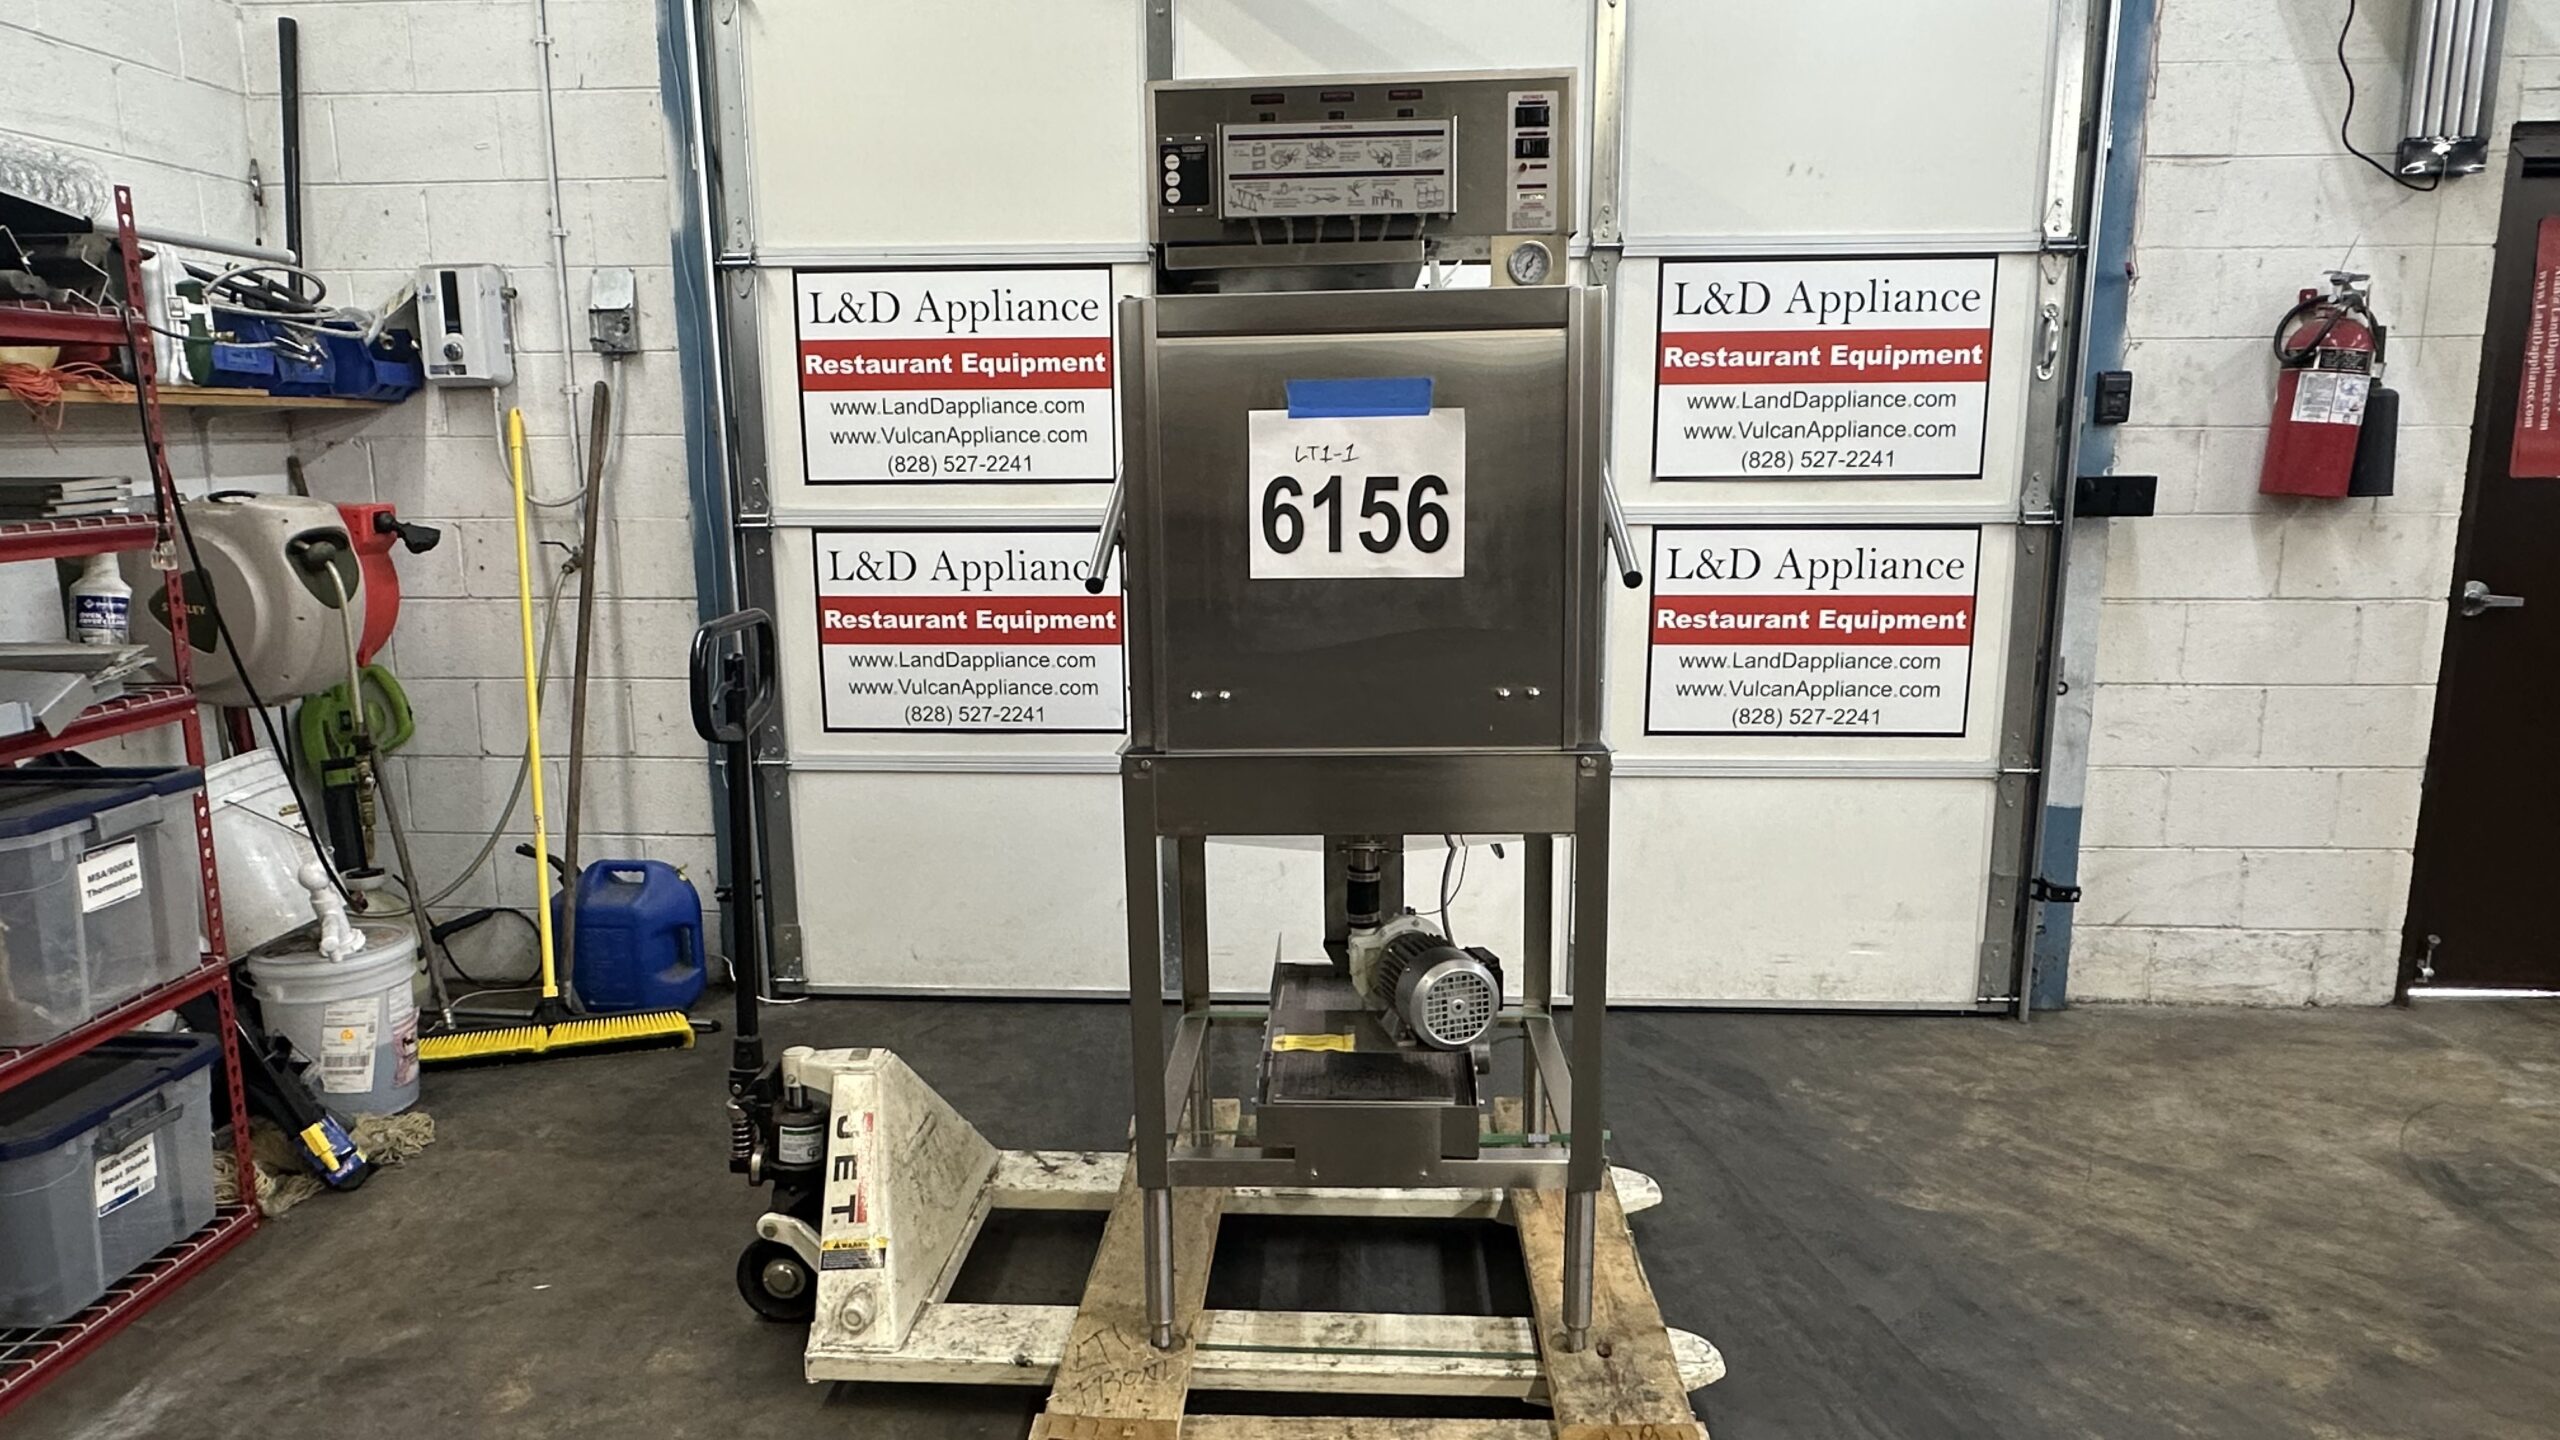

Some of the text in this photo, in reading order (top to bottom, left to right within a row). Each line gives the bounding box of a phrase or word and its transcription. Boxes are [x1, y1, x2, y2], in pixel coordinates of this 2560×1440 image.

[809, 288, 1099, 333] L&D Appliance
[1673, 279, 1981, 325] L&D Appliance
[1663, 344, 1983, 370] Restaurant Equipment
[2523, 270, 2548, 428] www.LandDappliance.com
[805, 352, 1106, 378] Restaurant Equipment
[830, 396, 1085, 418] www.LandDappliance.com
[1687, 390, 1956, 412] www.LandDappliance.com
[830, 425, 1087, 447] www.VulcanAppliance.com
[1683, 420, 1956, 442] www.VulcanAppliance.com
[1295, 443, 1359, 463] LT1-1
[1741, 450, 1894, 472] (828) 527-2241
[888, 455, 1032, 477] (828) 527-2241
[1262, 474, 1450, 554] 6156
[828, 549, 1107, 592] L&D Applianc
[1666, 547, 1964, 590] L&D Appliance
[824, 609, 1116, 632] Restaurant Equipment
[1657, 609, 1967, 634] Restaurant Equipment
[849, 651, 1096, 671] www.LandDappliance.com
[1679, 652, 1941, 673] www.LandDappliance.com
[849, 679, 1099, 698] www.VulcanAppliance.com
[1676, 680, 1941, 701] www.VulcanAppliance.com
[904, 706, 1044, 725] (828) 527-2241
[1731, 708, 1880, 729] (828) 527-2241
[831, 1115, 859, 1223] JET
